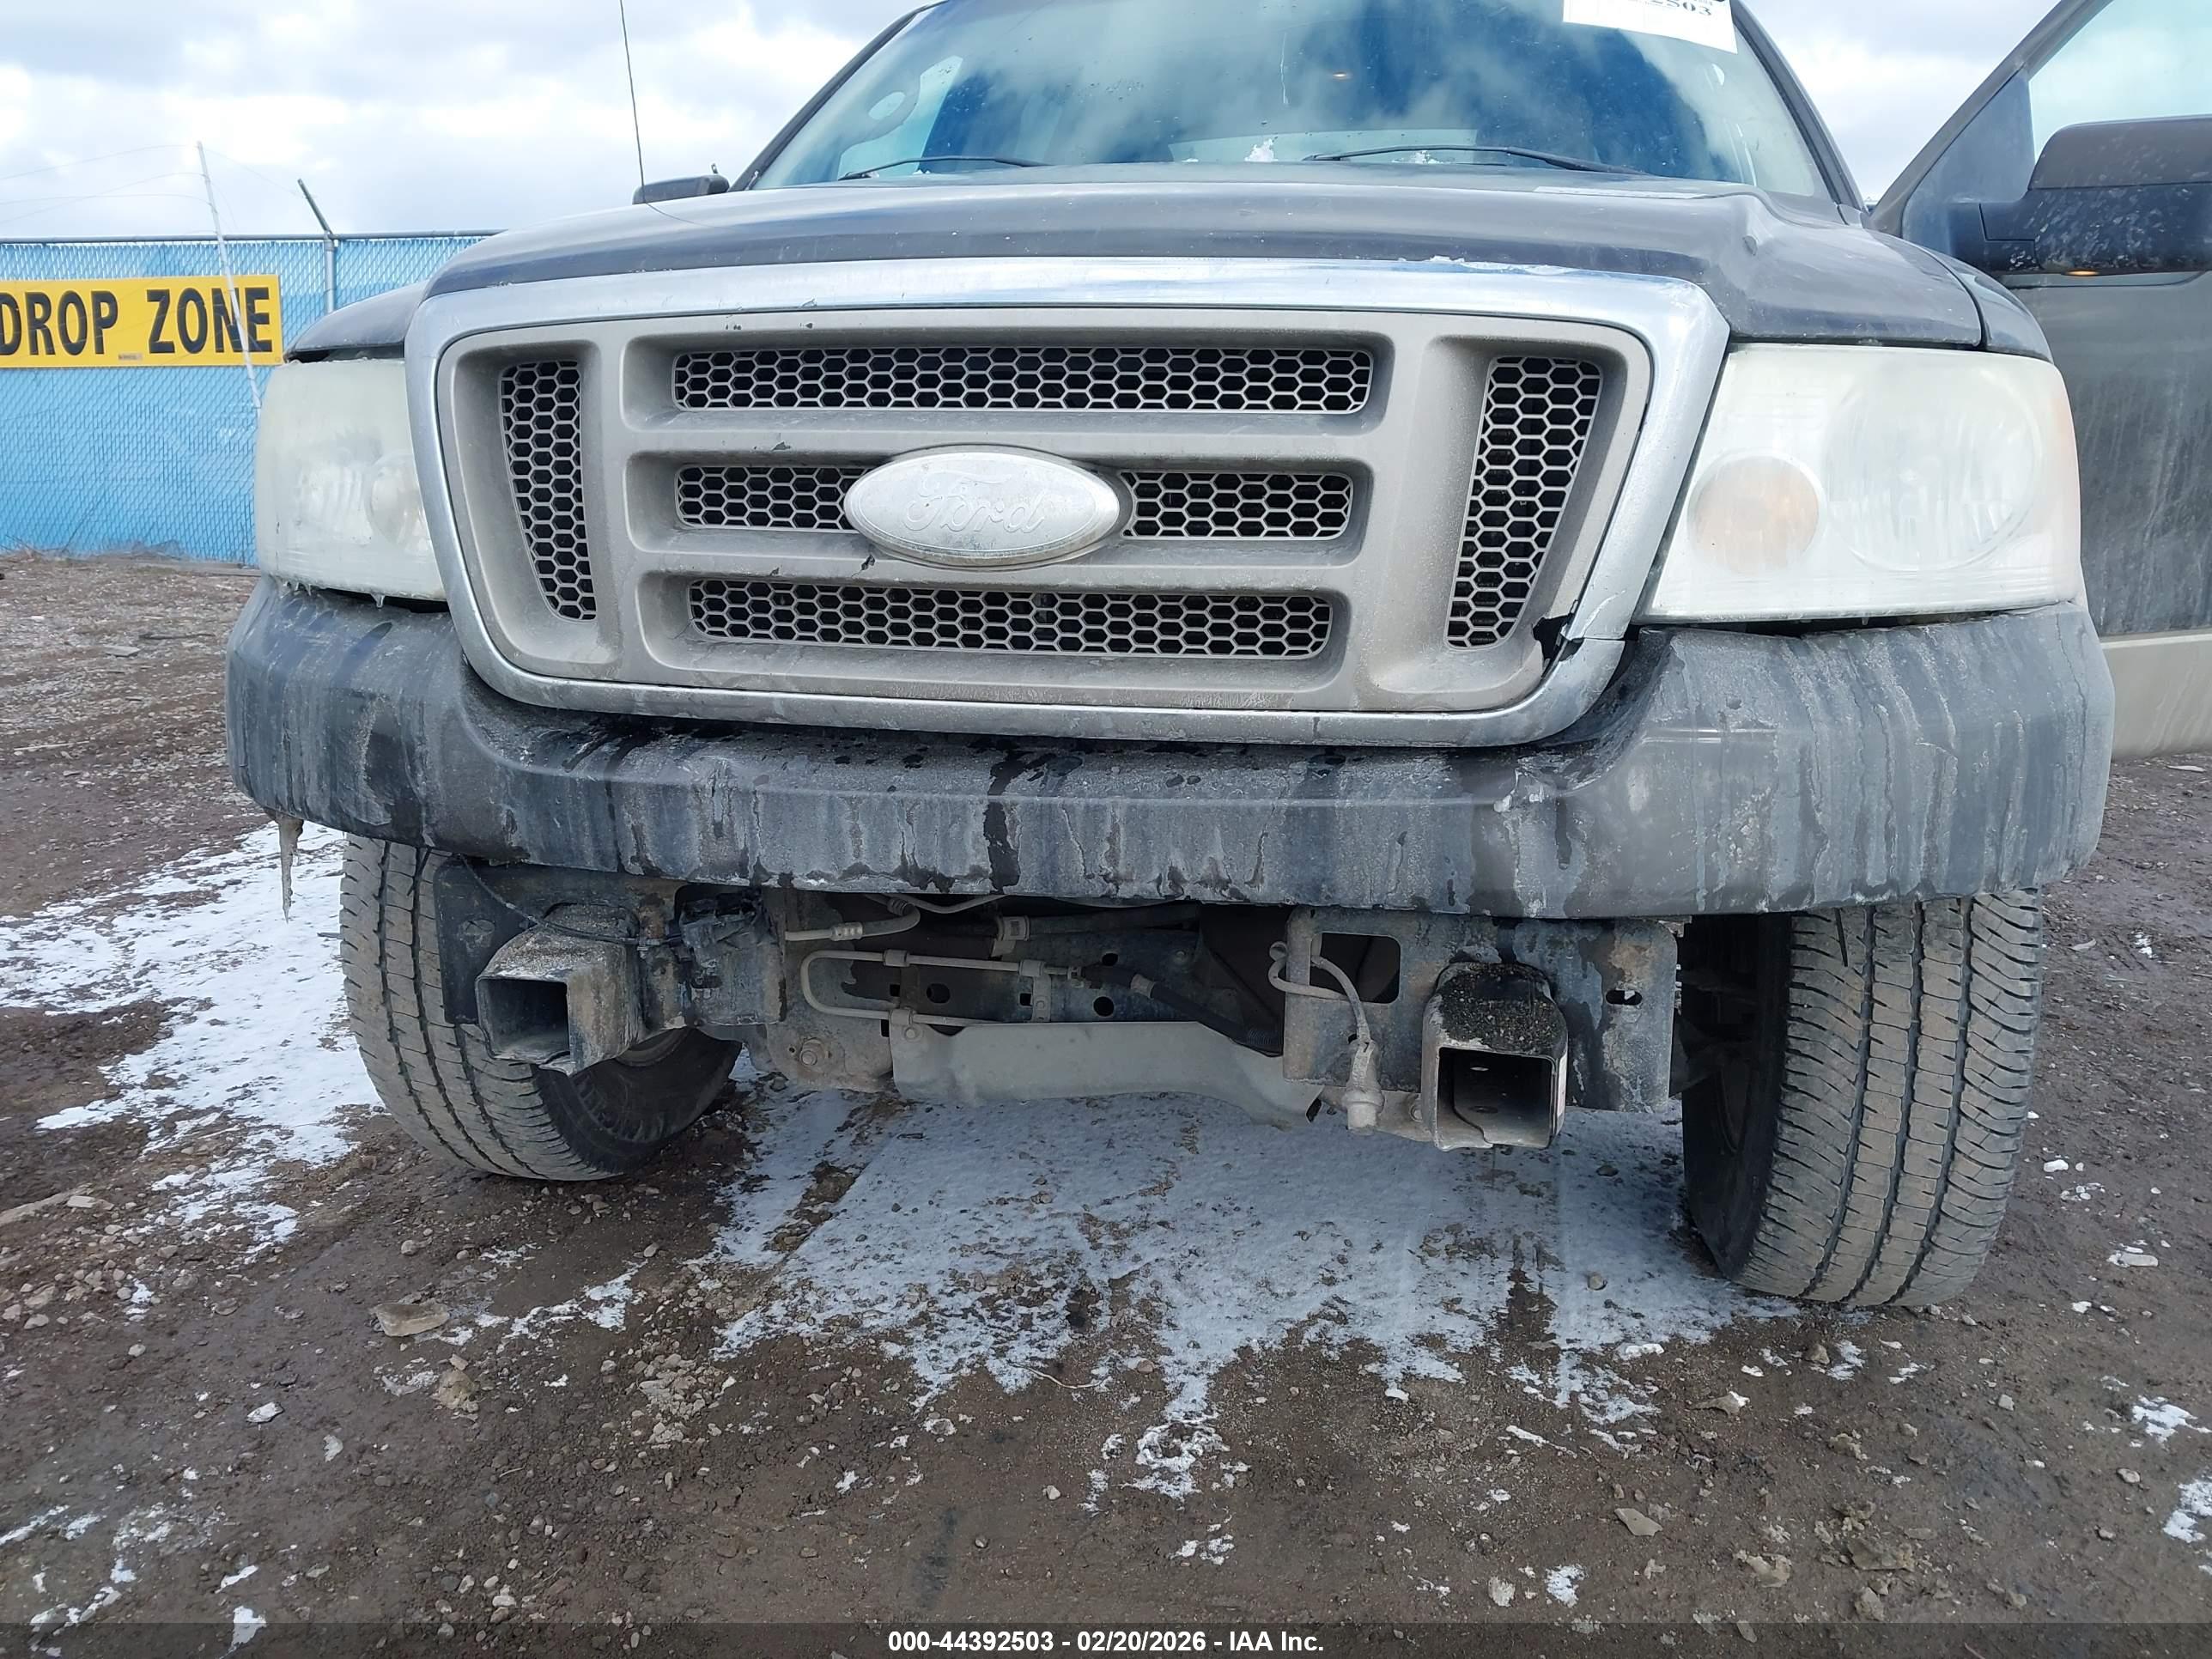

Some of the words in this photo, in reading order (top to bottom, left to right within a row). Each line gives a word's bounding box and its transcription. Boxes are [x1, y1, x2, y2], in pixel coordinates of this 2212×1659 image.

[0, 290, 118, 356] DROP
[146, 287, 273, 354] ZONE
[901, 471, 1047, 533] Ford
